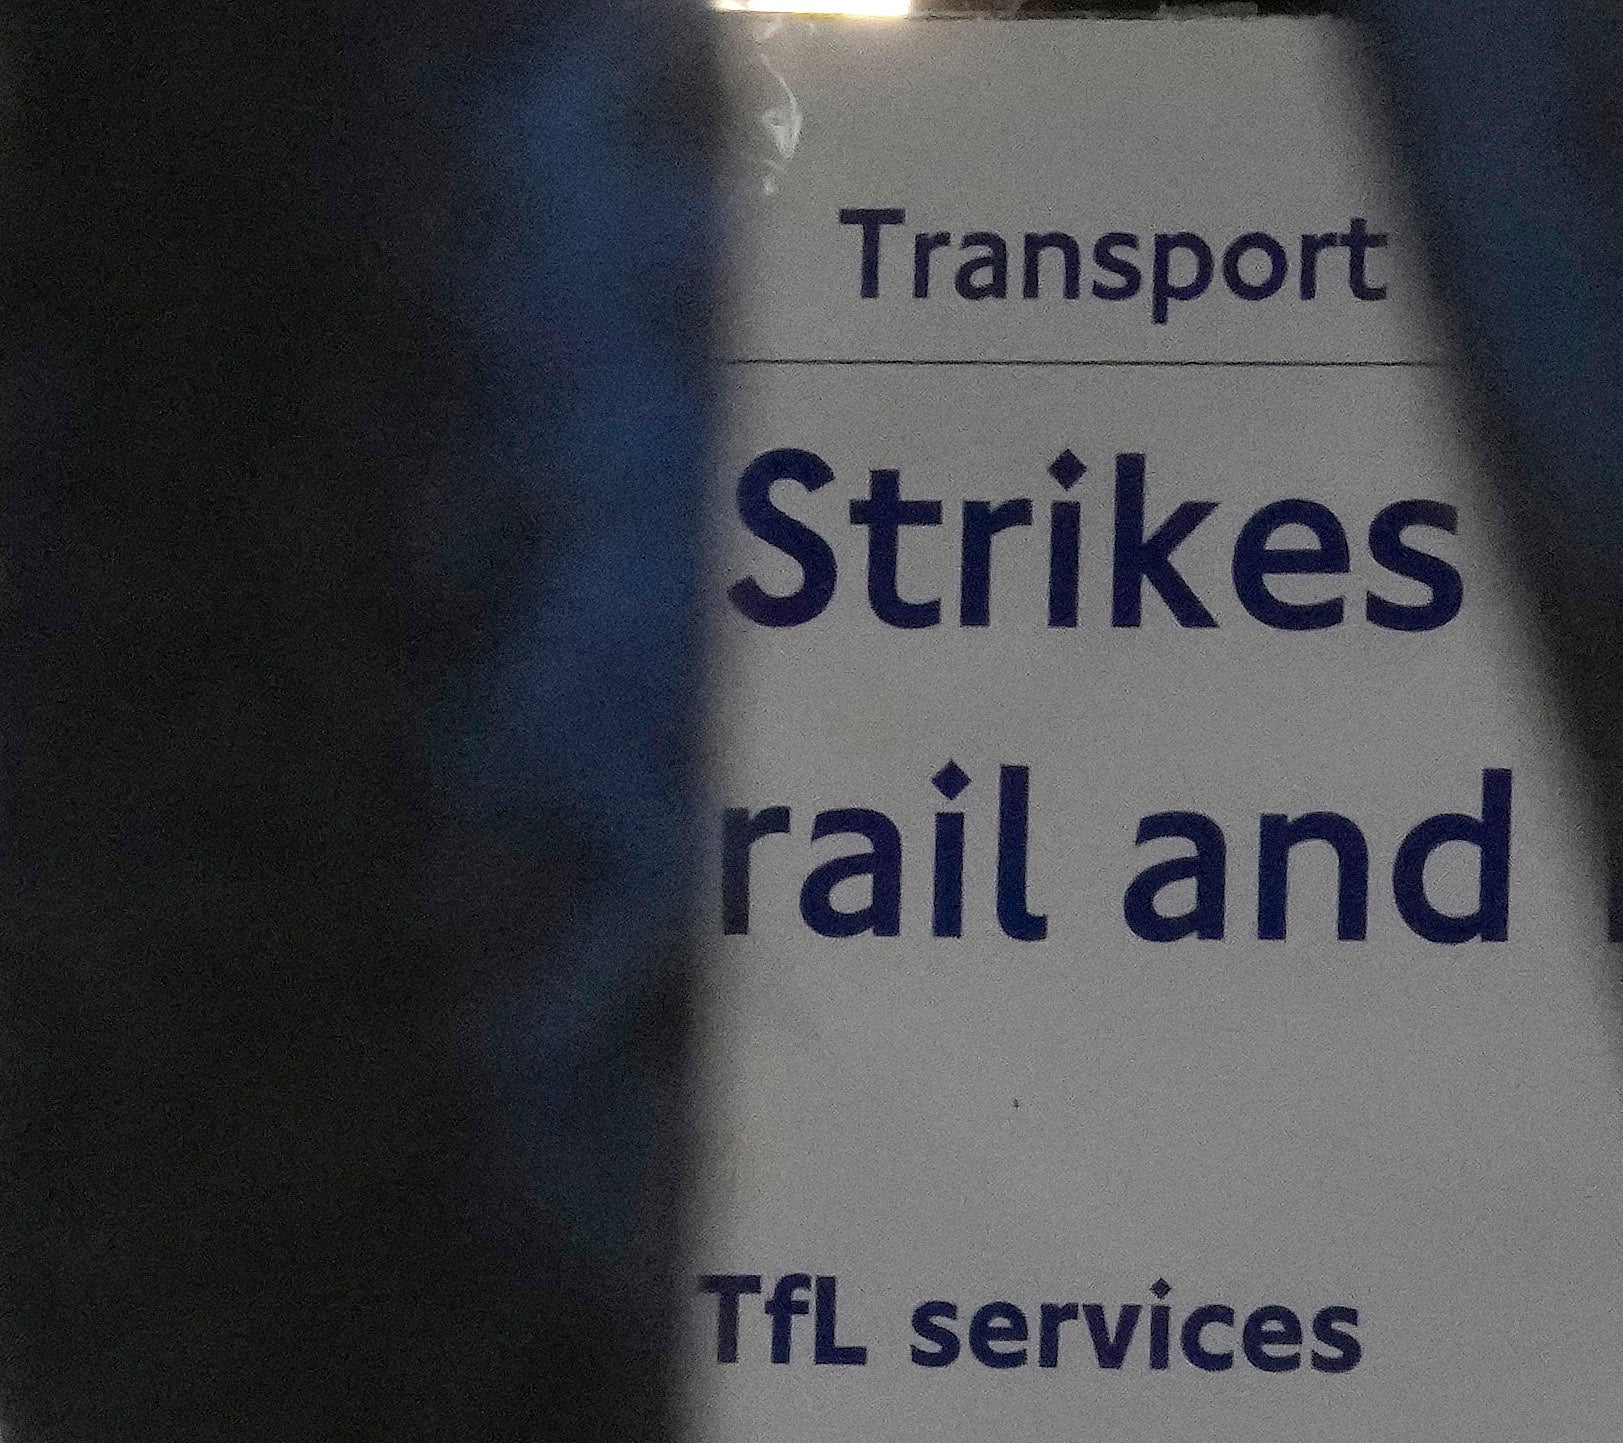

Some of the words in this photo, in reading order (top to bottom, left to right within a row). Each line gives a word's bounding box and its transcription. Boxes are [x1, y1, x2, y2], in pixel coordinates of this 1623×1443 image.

[838, 207, 1388, 325] Transport
[728, 447, 1464, 633] Strikes
[722, 760, 1048, 943] rail
[1123, 767, 1514, 946] and
[698, 1272, 868, 1366] TfL
[910, 1278, 1362, 1374] services
